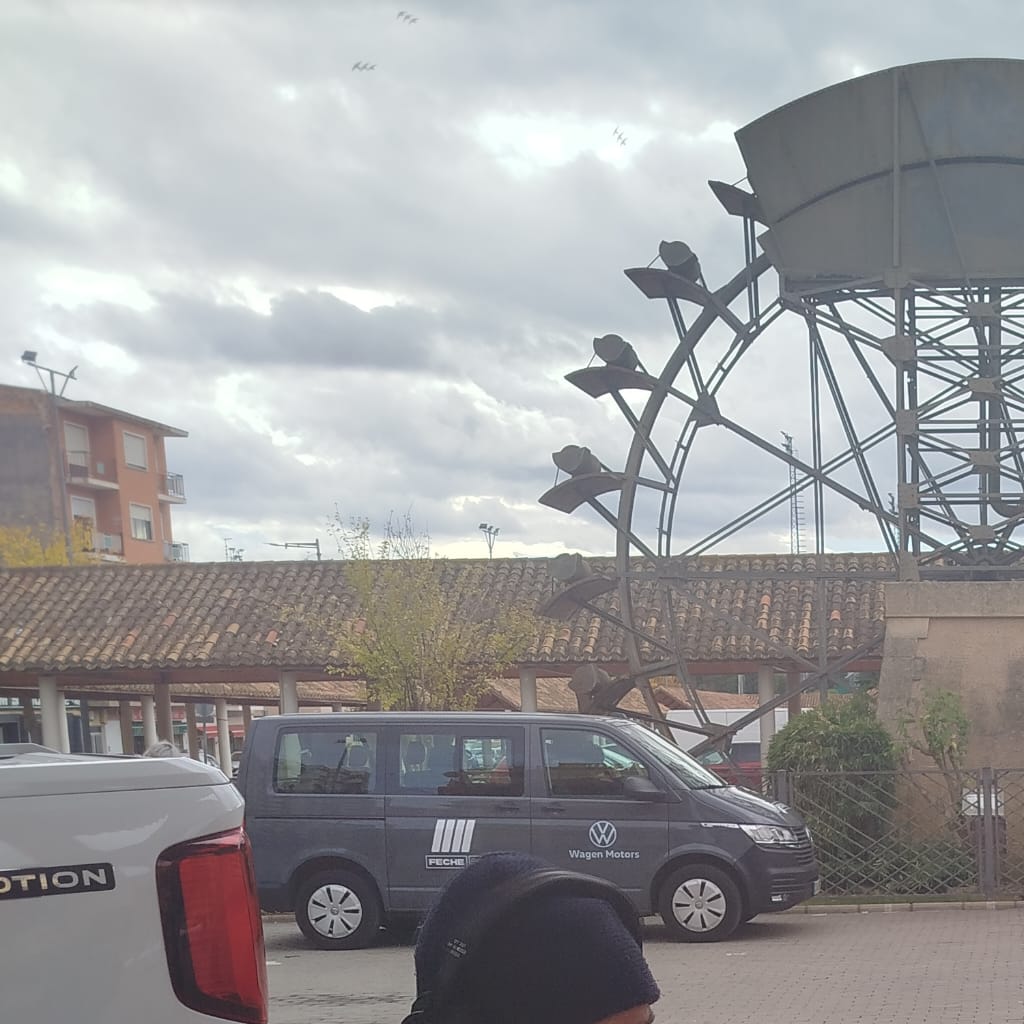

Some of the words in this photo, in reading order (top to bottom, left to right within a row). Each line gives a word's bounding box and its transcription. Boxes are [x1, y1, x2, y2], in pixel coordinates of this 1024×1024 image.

[569, 850, 604, 860] Wagen
[605, 850, 640, 859] Motors
[428, 858, 465, 866] FECHE
